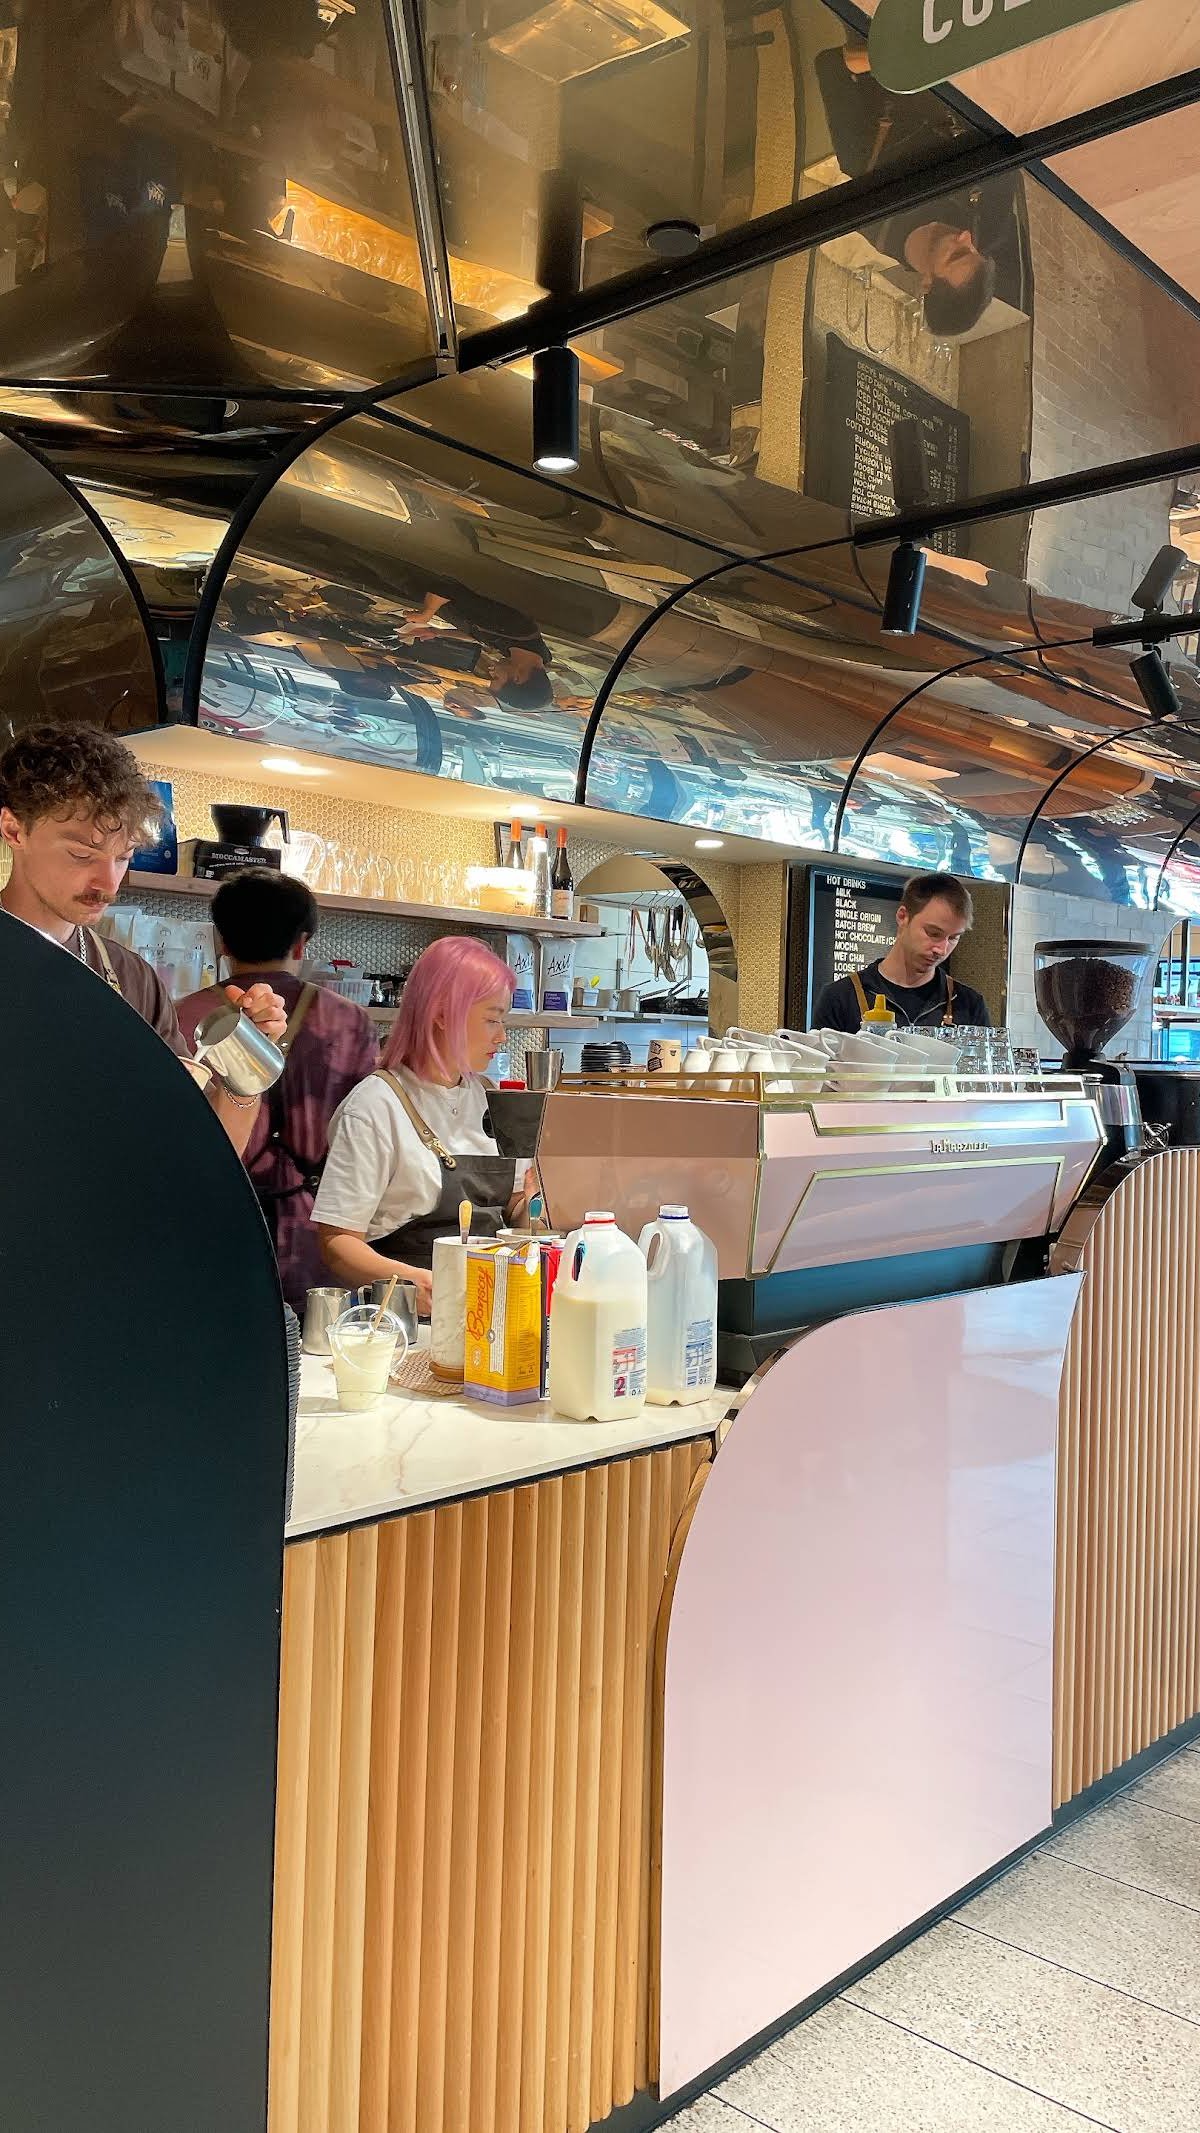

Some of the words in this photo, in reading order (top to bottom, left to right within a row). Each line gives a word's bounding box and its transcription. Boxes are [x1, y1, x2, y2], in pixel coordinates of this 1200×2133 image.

[211, 852, 267, 864] MOCCAMASTER
[826, 875, 841, 886] HOT
[842, 877, 867, 889] DRINKS
[835, 887, 852, 898] MILK
[835, 898, 857, 909] BLACK
[834, 908, 859, 921] SINGLE
[859, 911, 882, 923] ORIGIN
[834, 919, 857, 931] BATCH
[857, 922, 876, 933] BREW
[834, 930, 848, 941] HOT
[834, 941, 859, 952] MOCHA
[833, 950, 848, 961] WET
[848, 953, 865, 963] CHAI
[547, 953, 571, 975] Axil
[834, 961, 856, 973] LOOSE
[466, 1265, 494, 1341] Bonsoy
